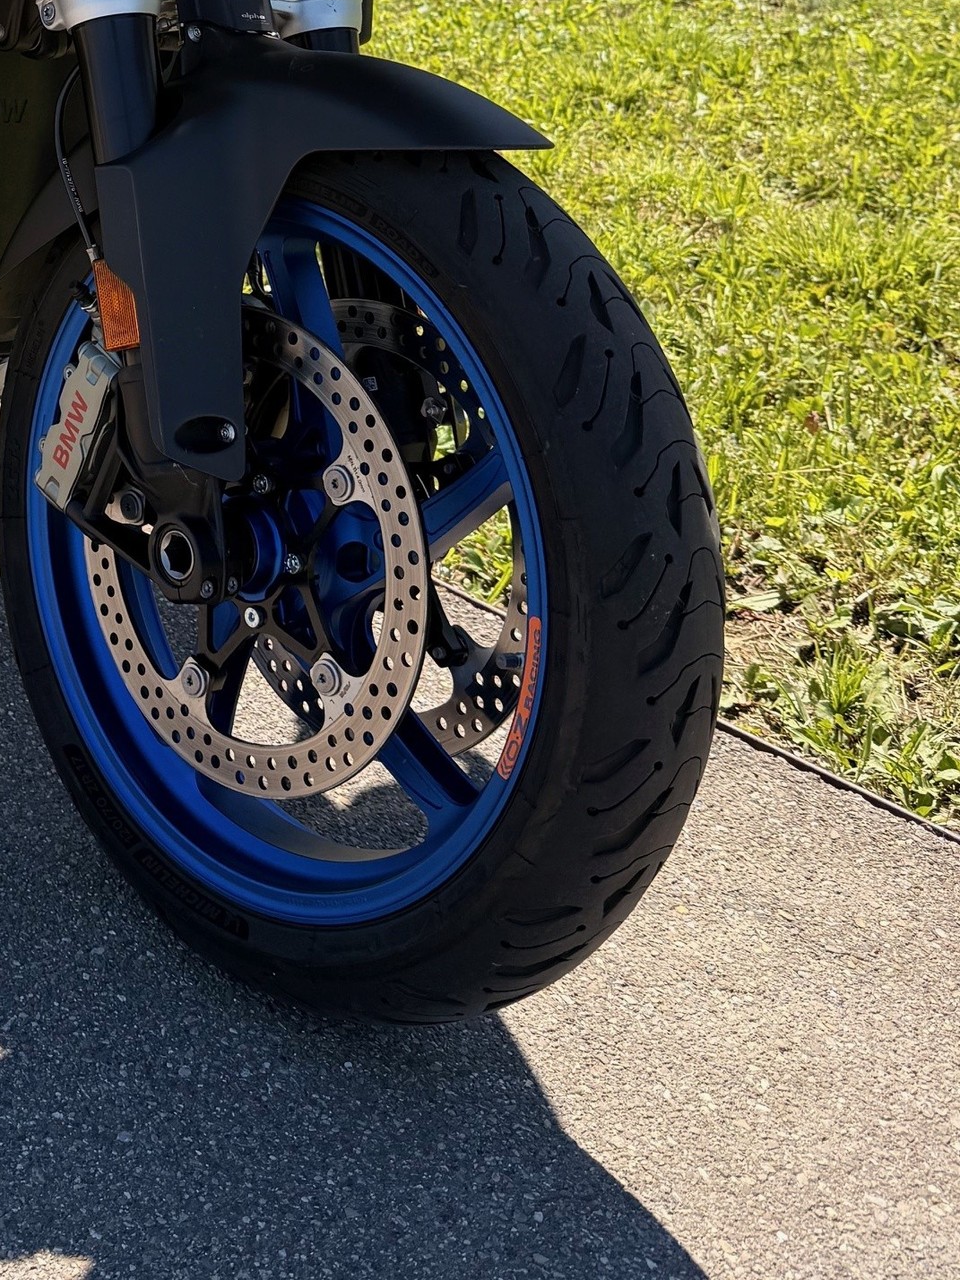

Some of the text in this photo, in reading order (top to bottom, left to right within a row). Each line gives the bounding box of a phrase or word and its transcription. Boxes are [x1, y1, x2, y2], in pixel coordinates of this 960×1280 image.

[52, 389, 88, 470] BMW
[524, 629, 541, 710] RACING
[141, 852, 221, 921] MICHELIN
